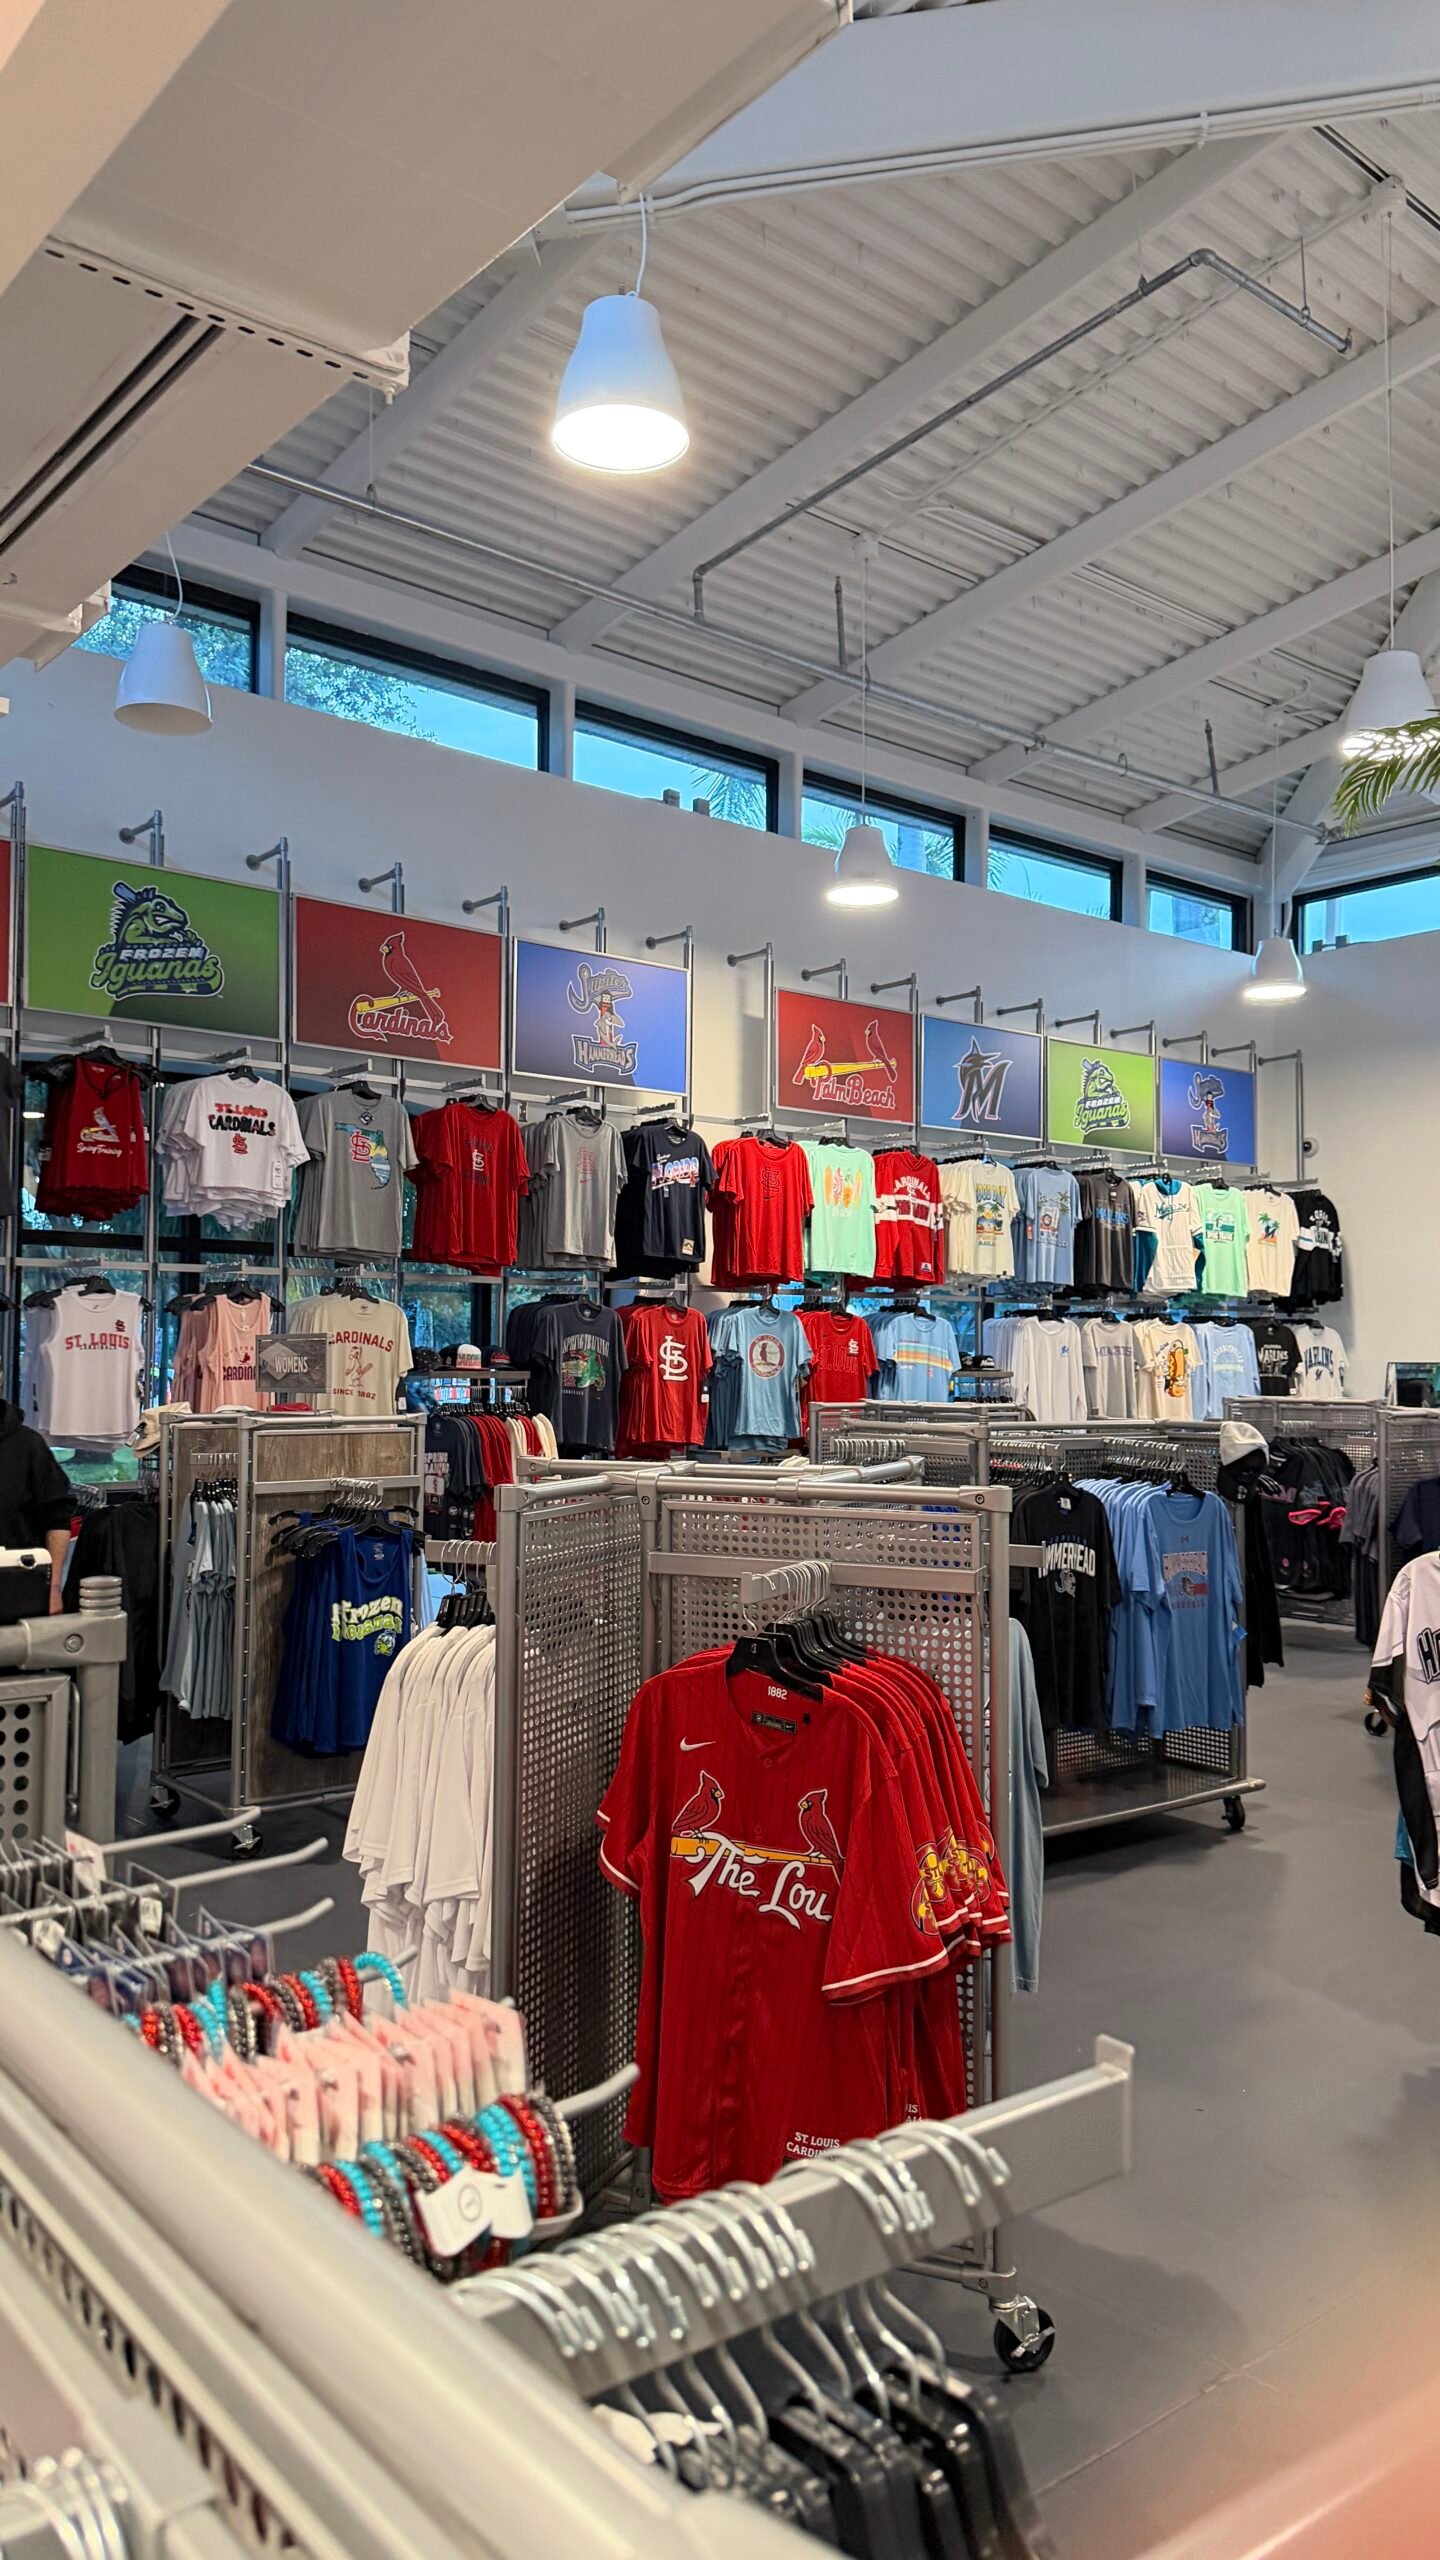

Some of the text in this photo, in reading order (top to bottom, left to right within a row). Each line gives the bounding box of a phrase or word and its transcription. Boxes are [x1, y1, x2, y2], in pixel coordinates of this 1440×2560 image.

[120, 947, 205, 961] FROZEN
[91, 951, 221, 996] Iguanas
[348, 993, 454, 1044] Cardinals
[847, 1073, 896, 1109] Beach
[1085, 1097, 1122, 1109] FROZEN
[208, 1114, 276, 1136] CARDINALS
[1074, 1101, 1129, 1130] Iguanas
[90, 1332, 130, 1350] LOUIS
[332, 1331, 394, 1353] ARDINALS
[275, 1356, 308, 1373] WOMENS
[333, 1388, 354, 1396] SINCE
[768, 1685, 788, 1700] 1882
[684, 1831, 832, 1930] The Lou
[810, 2136, 840, 2149] LOUIS
